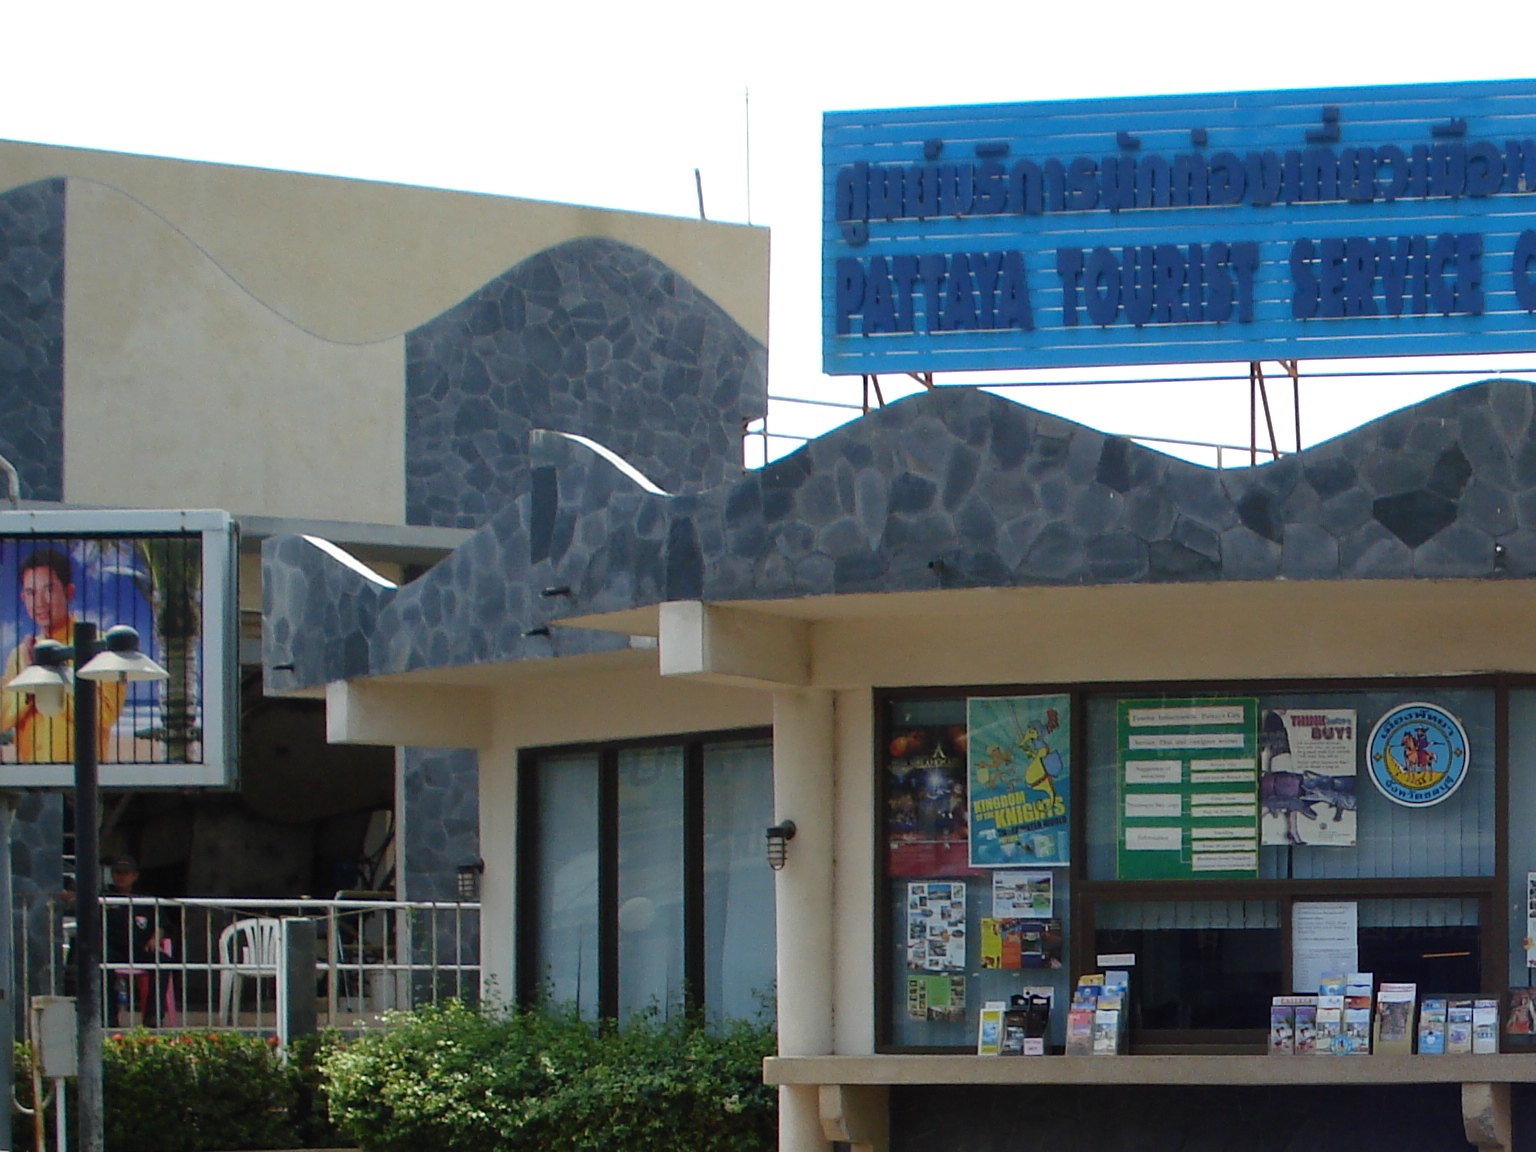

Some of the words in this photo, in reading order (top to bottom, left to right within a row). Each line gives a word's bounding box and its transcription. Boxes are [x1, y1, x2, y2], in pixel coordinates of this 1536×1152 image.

[835, 250, 1033, 336] PATTAYA
[1057, 241, 1259, 328] TOURIST
[1290, 232, 1484, 321] SERVICE
[1290, 715, 1326, 727] THINK
[973, 791, 1026, 813] KINGDOM
